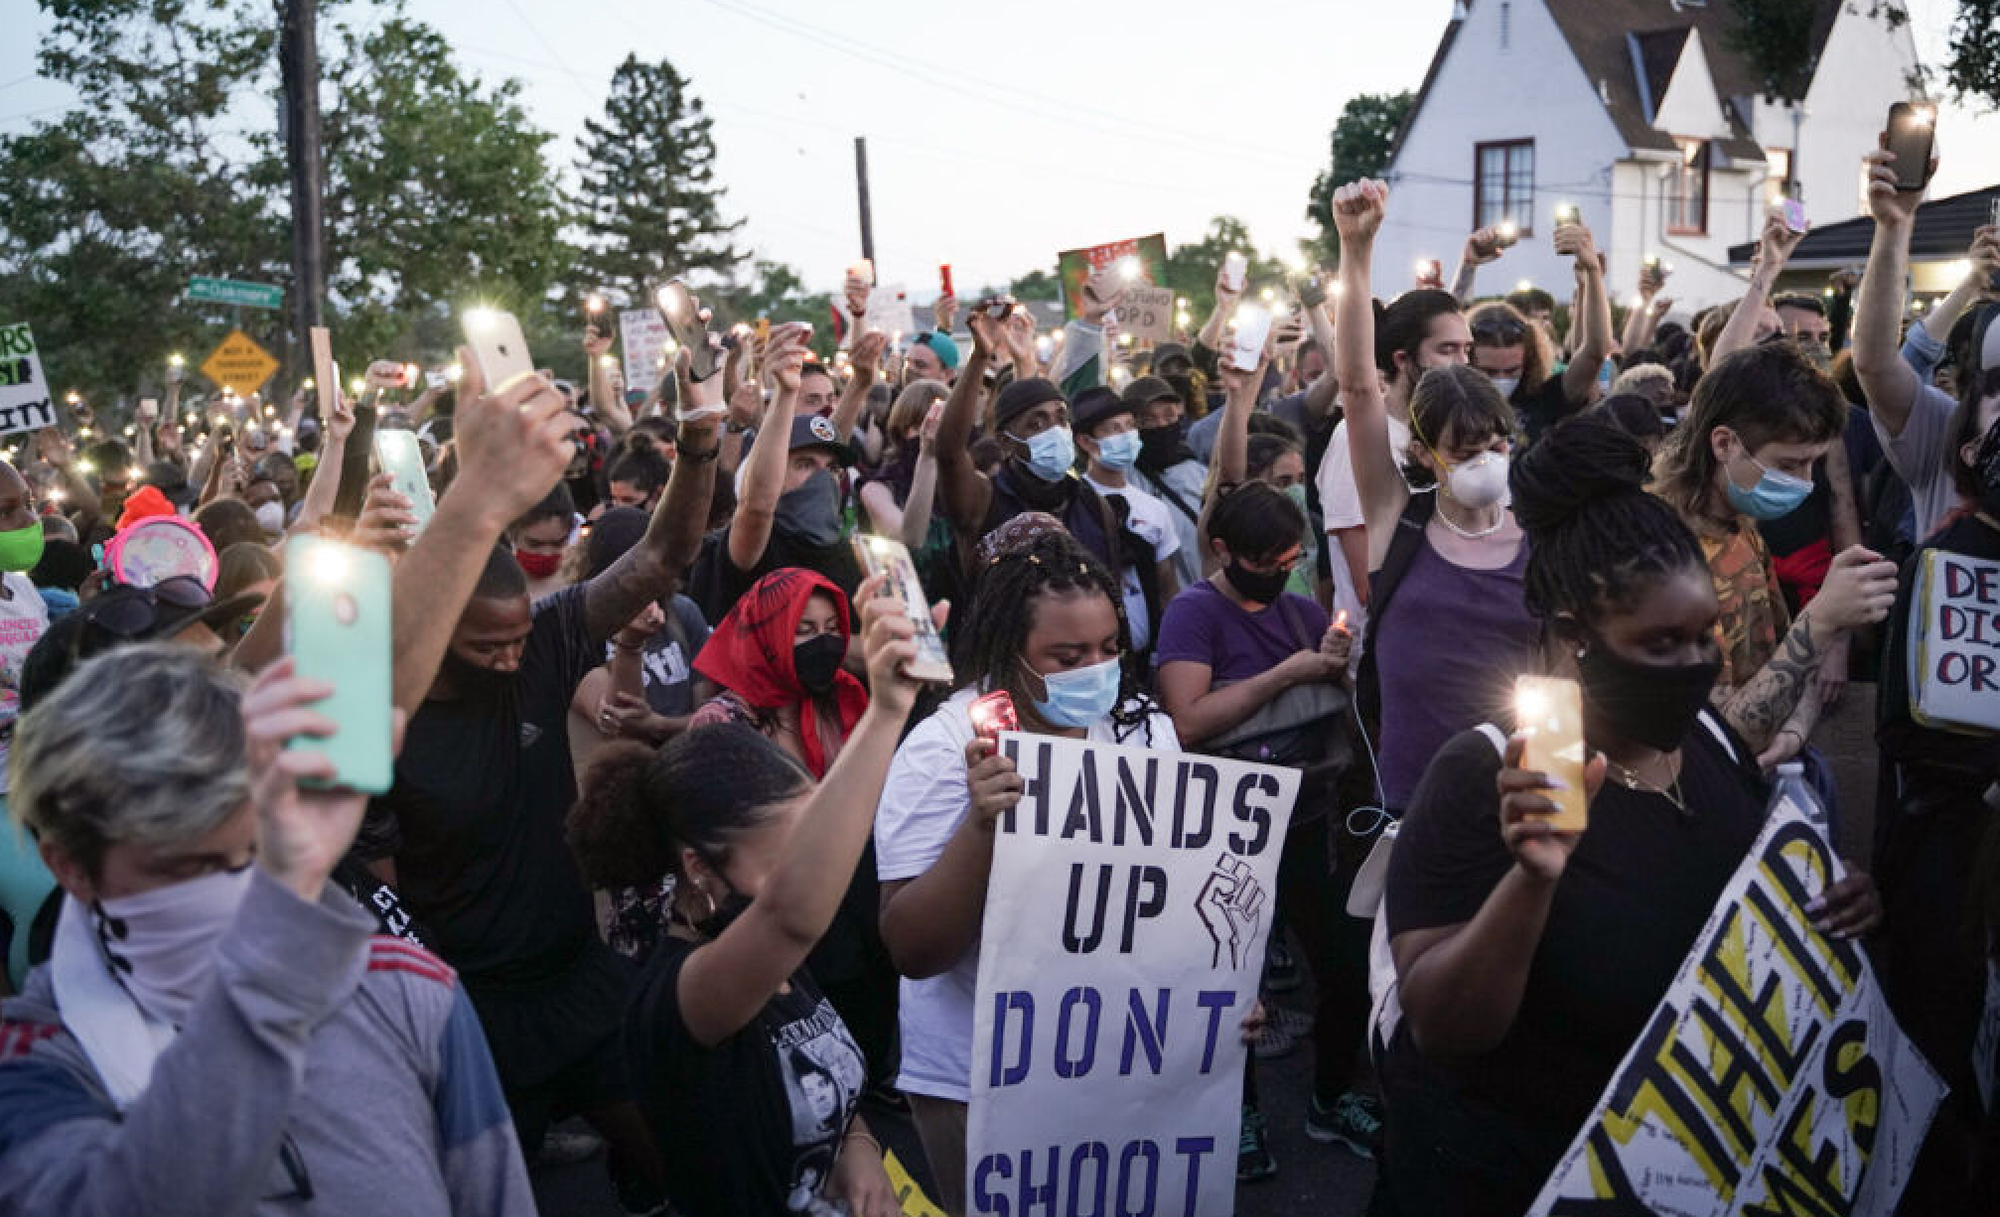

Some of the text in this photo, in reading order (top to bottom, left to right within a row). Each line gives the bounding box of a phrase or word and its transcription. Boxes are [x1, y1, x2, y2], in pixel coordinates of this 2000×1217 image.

[1003, 739, 1280, 857] HANDS
[1061, 863, 1168, 954] UP
[989, 986, 1236, 1087] DONT
[974, 1136, 1214, 1217] SHOOT
